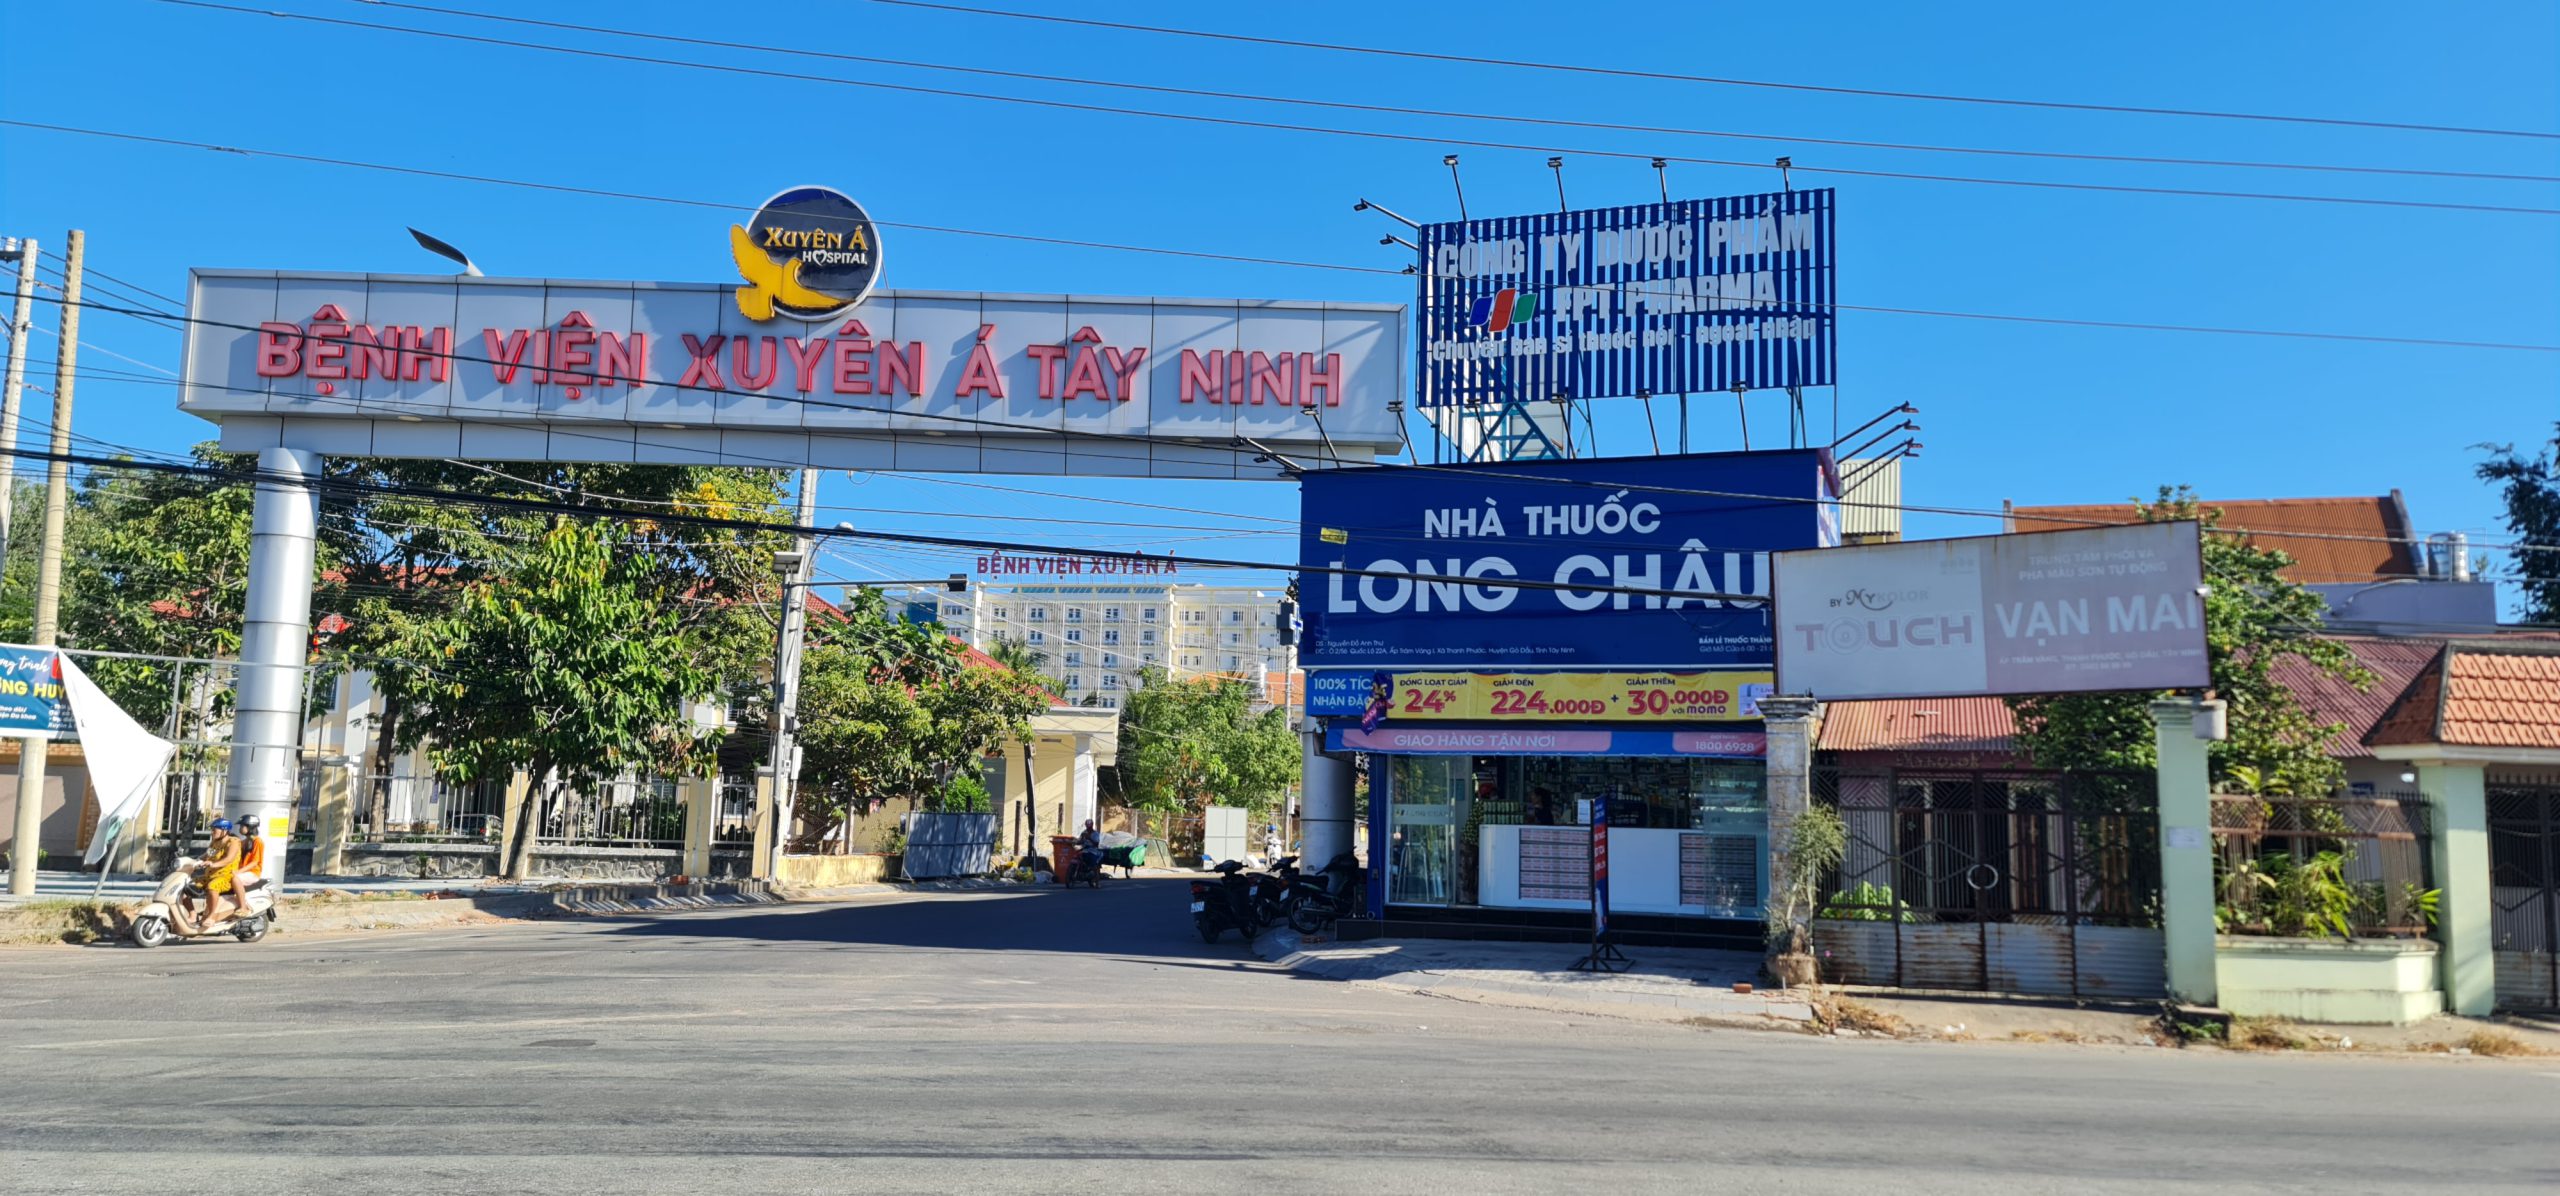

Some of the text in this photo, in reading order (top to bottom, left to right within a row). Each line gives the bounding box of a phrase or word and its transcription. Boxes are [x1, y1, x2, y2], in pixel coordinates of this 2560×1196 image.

[848, 224, 868, 251] Á
[1437, 236, 1525, 278] CÔNG
[1539, 233, 1581, 271] TY
[1597, 222, 1692, 267] DƯỢC
[1556, 270, 1777, 323] FPT PHARMA
[1579, 323, 1636, 351] thuốc
[255, 304, 1341, 407] BỆNH VIỆN XUYÊN Á TÂY NINH
[1424, 489, 1661, 538] NHÀ THUỐC
[977, 550, 1178, 580] BỆNH VIỆN XUYÊN Á
[1328, 538, 1771, 614] LONG CHÂU
[2019, 570, 2045, 581] PHA
[1830, 599, 1842, 608] BY
[1995, 590, 2198, 647] VẠN MAI
[1795, 615, 1973, 655] TOUCH
[1313, 676, 1373, 690] 100% TÍC
[1651, 676, 1676, 686] THÊM
[1313, 696, 1345, 709] NHẬN
[1404, 688, 1457, 714] 24%
[1394, 732, 1556, 750] GIAO HÀNG TẬN NƠI
[1695, 741, 1755, 752] 1800 6928
